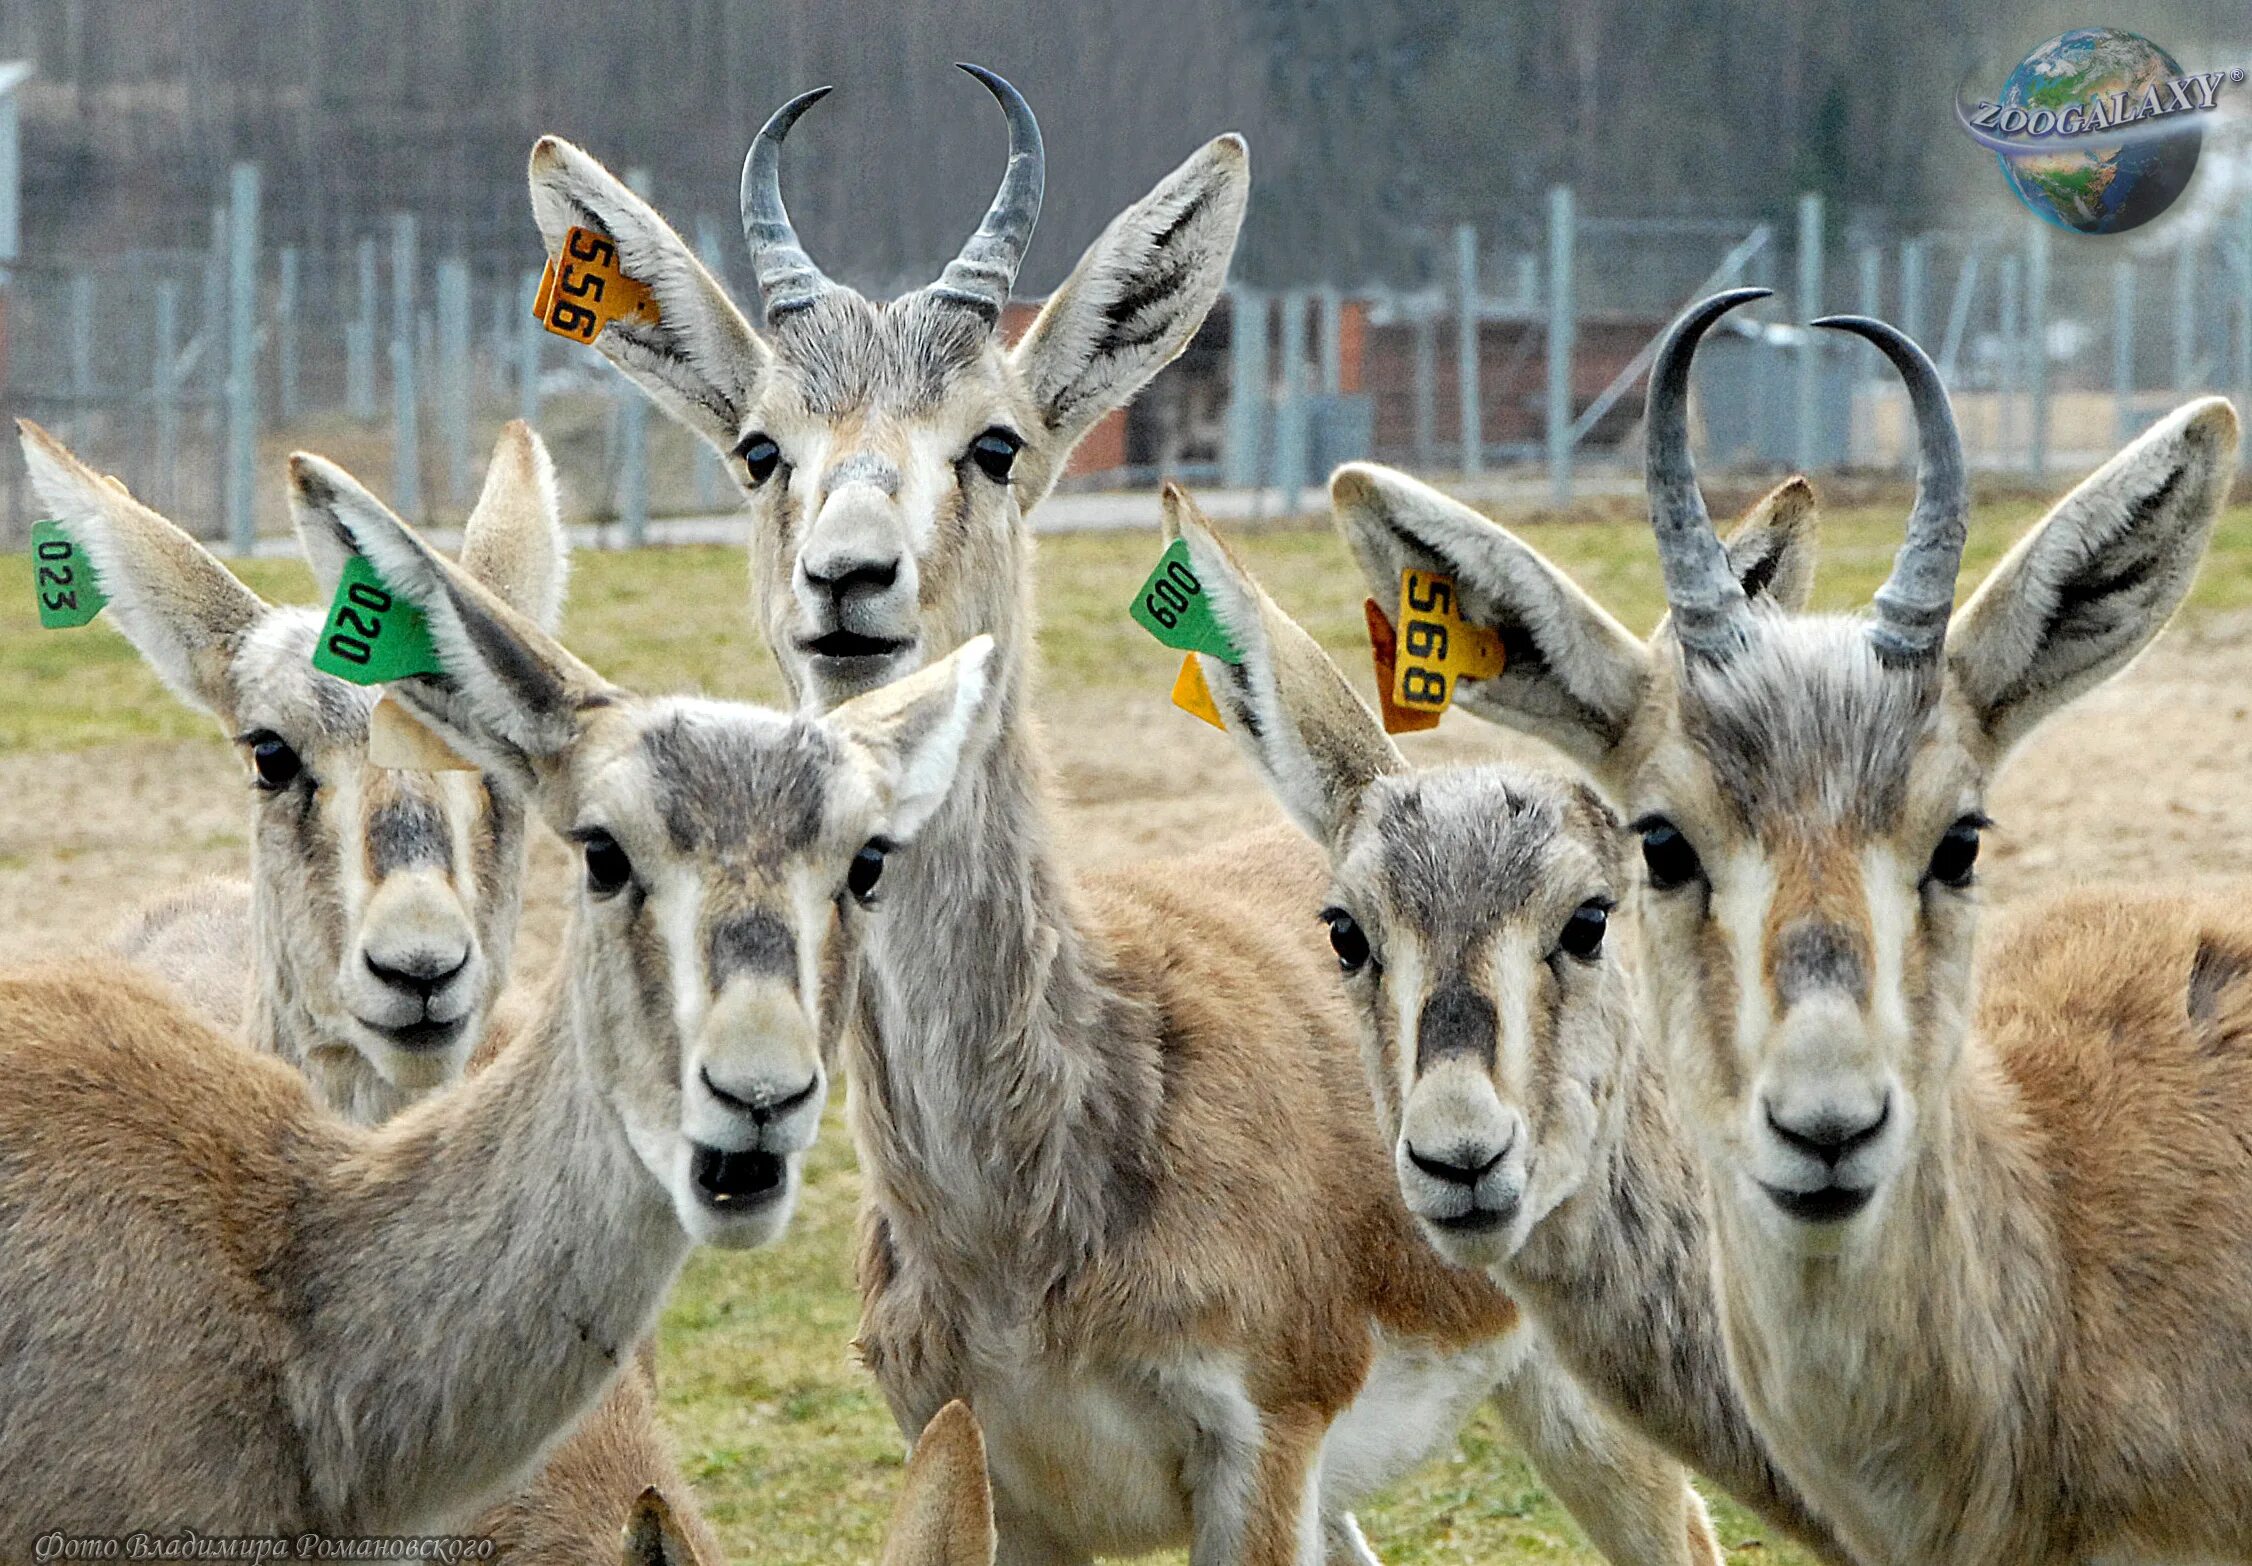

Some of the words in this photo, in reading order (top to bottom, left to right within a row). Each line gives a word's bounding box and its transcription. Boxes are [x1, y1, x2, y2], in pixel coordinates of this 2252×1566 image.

[551, 230, 615, 338] 556
[38, 541, 78, 611] 023
[1145, 560, 1201, 630] 009
[328, 582, 392, 665] 020
[1402, 574, 1451, 705] 568
